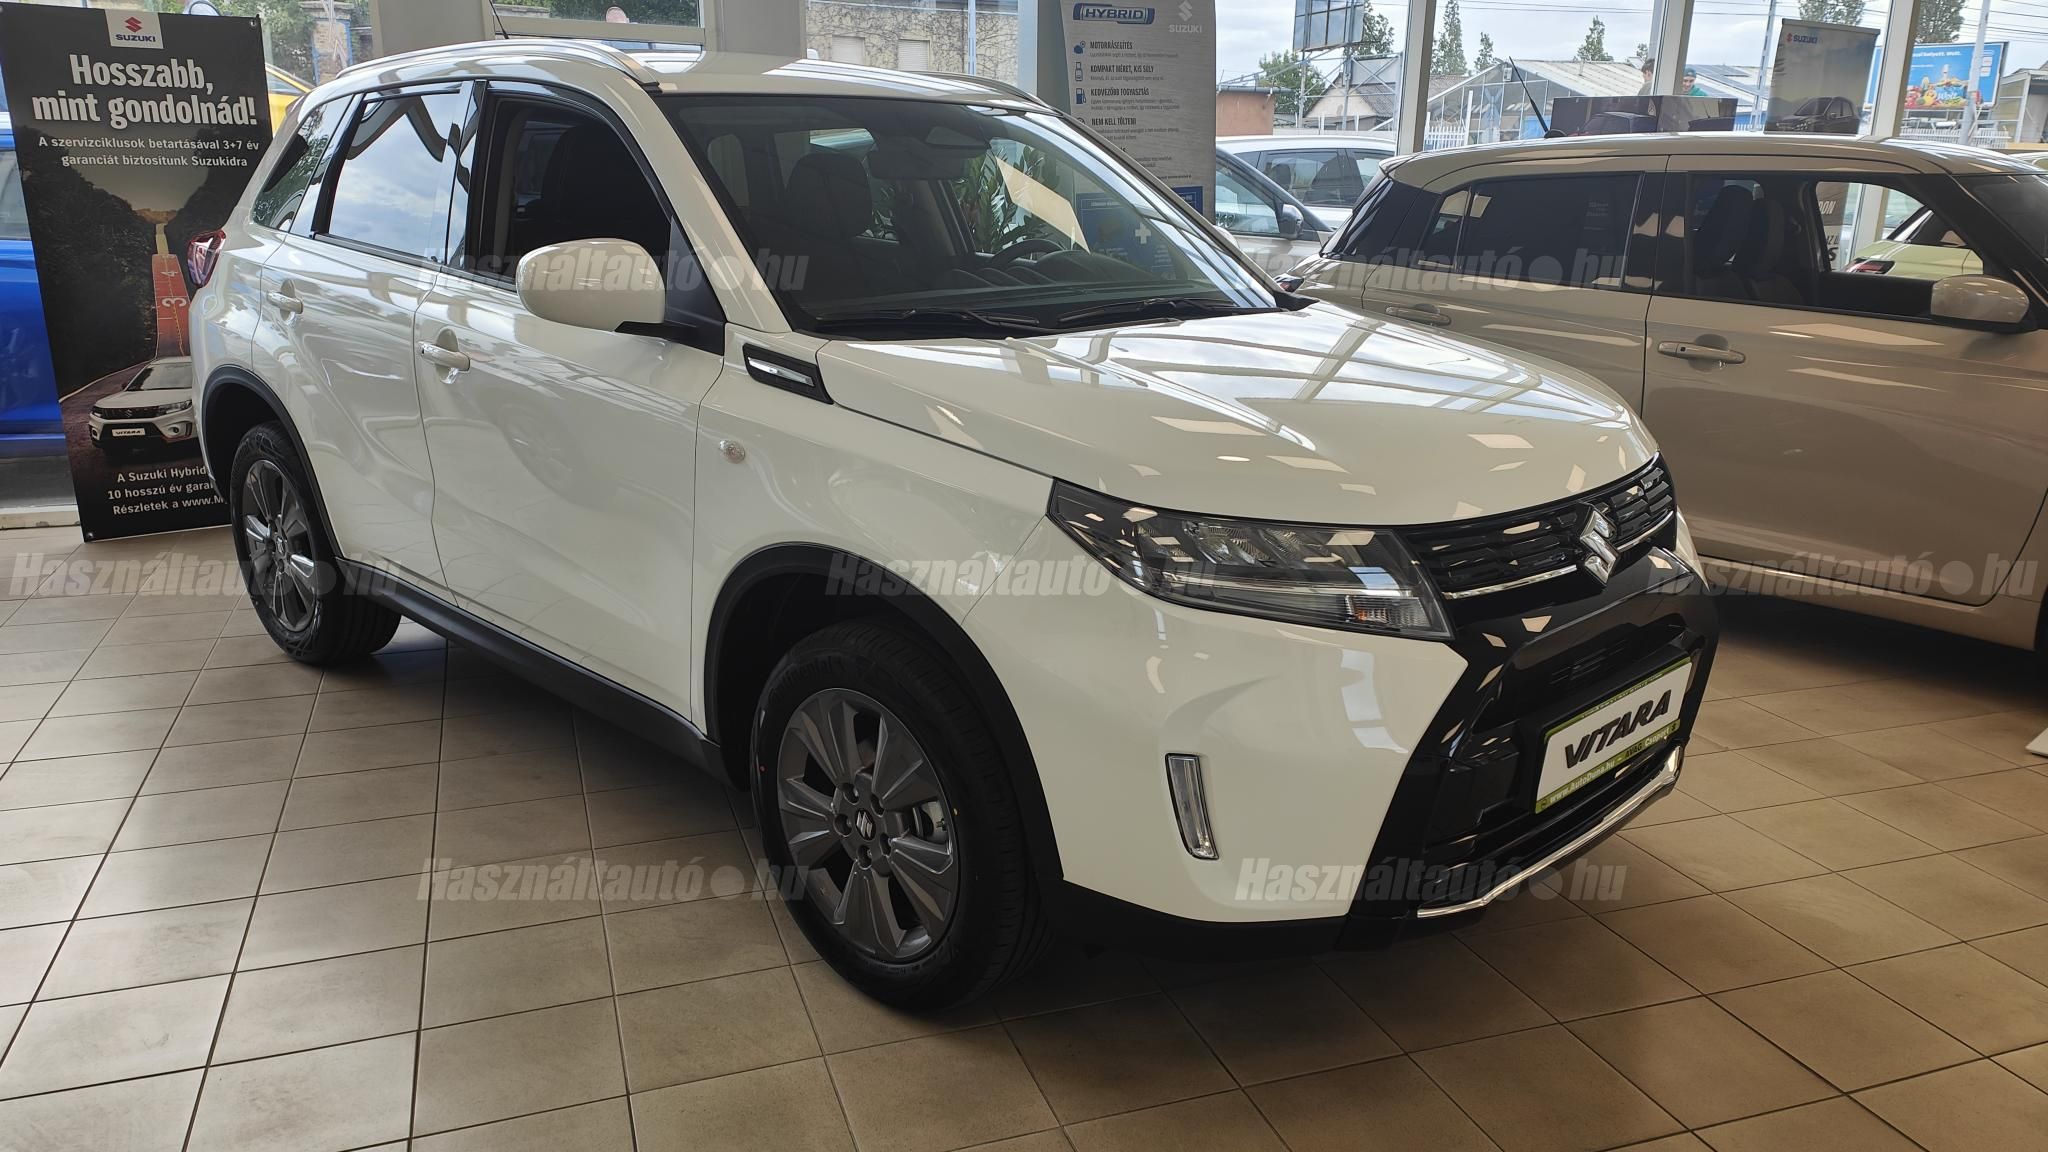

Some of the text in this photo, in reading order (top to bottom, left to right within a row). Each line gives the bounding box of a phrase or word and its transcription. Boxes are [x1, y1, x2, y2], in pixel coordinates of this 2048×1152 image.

[1085, 8, 1144, 20] HYBRID
[1168, 24, 1202, 33] SUZUKI
[115, 34, 156, 43] SUZUKI
[1793, 34, 1818, 44] SUZUKI
[69, 54, 214, 95] Hosszabb,
[1090, 65, 1115, 73] KOMPAKT
[32, 90, 258, 130] mint gondolnád!
[1092, 117, 1103, 126] NEM
[1104, 117, 1117, 126] KELL
[38, 137, 260, 151] A szervizciklusok betartásával 3+7 év
[62, 154, 248, 167] garanciát biztosítunk Suzukidra
[117, 473, 126, 483] A
[128, 469, 167, 482] Suzuki
[108, 490, 121, 500] 10
[125, 485, 166, 498] hosszú
[169, 484, 182, 493] év
[113, 500, 168, 515] Részletek
[1564, 689, 1672, 769] VITARA
